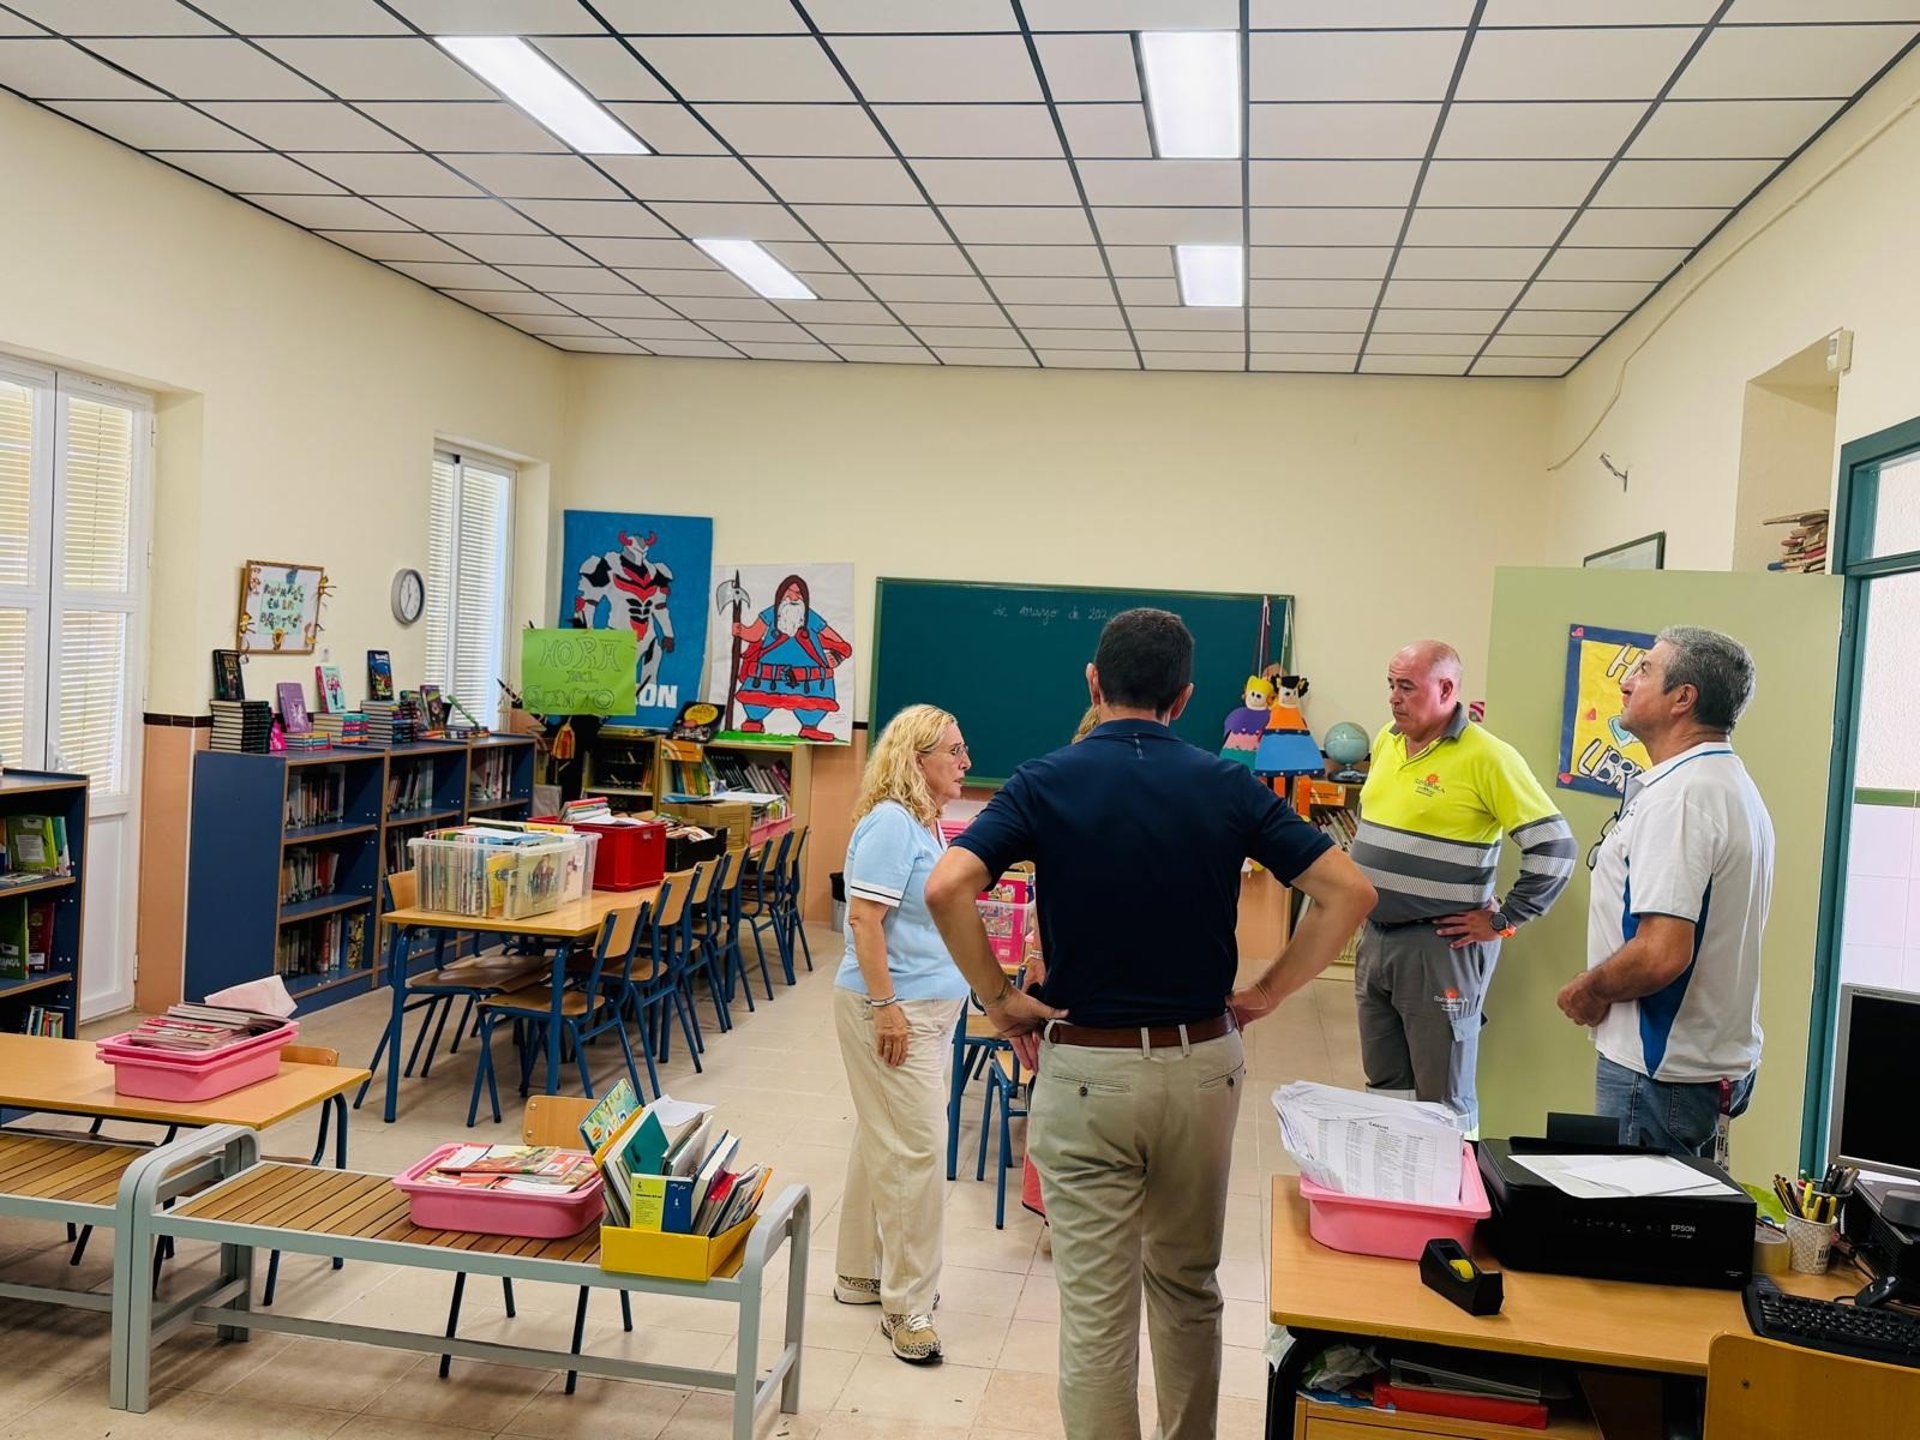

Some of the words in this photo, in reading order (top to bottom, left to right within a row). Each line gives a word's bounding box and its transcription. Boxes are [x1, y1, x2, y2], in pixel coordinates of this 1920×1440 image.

[1019, 604, 1058, 626] mayo
[539, 636, 621, 672] HORA
[636, 683, 678, 708] ON
[1670, 1224, 1697, 1233] EPSON
